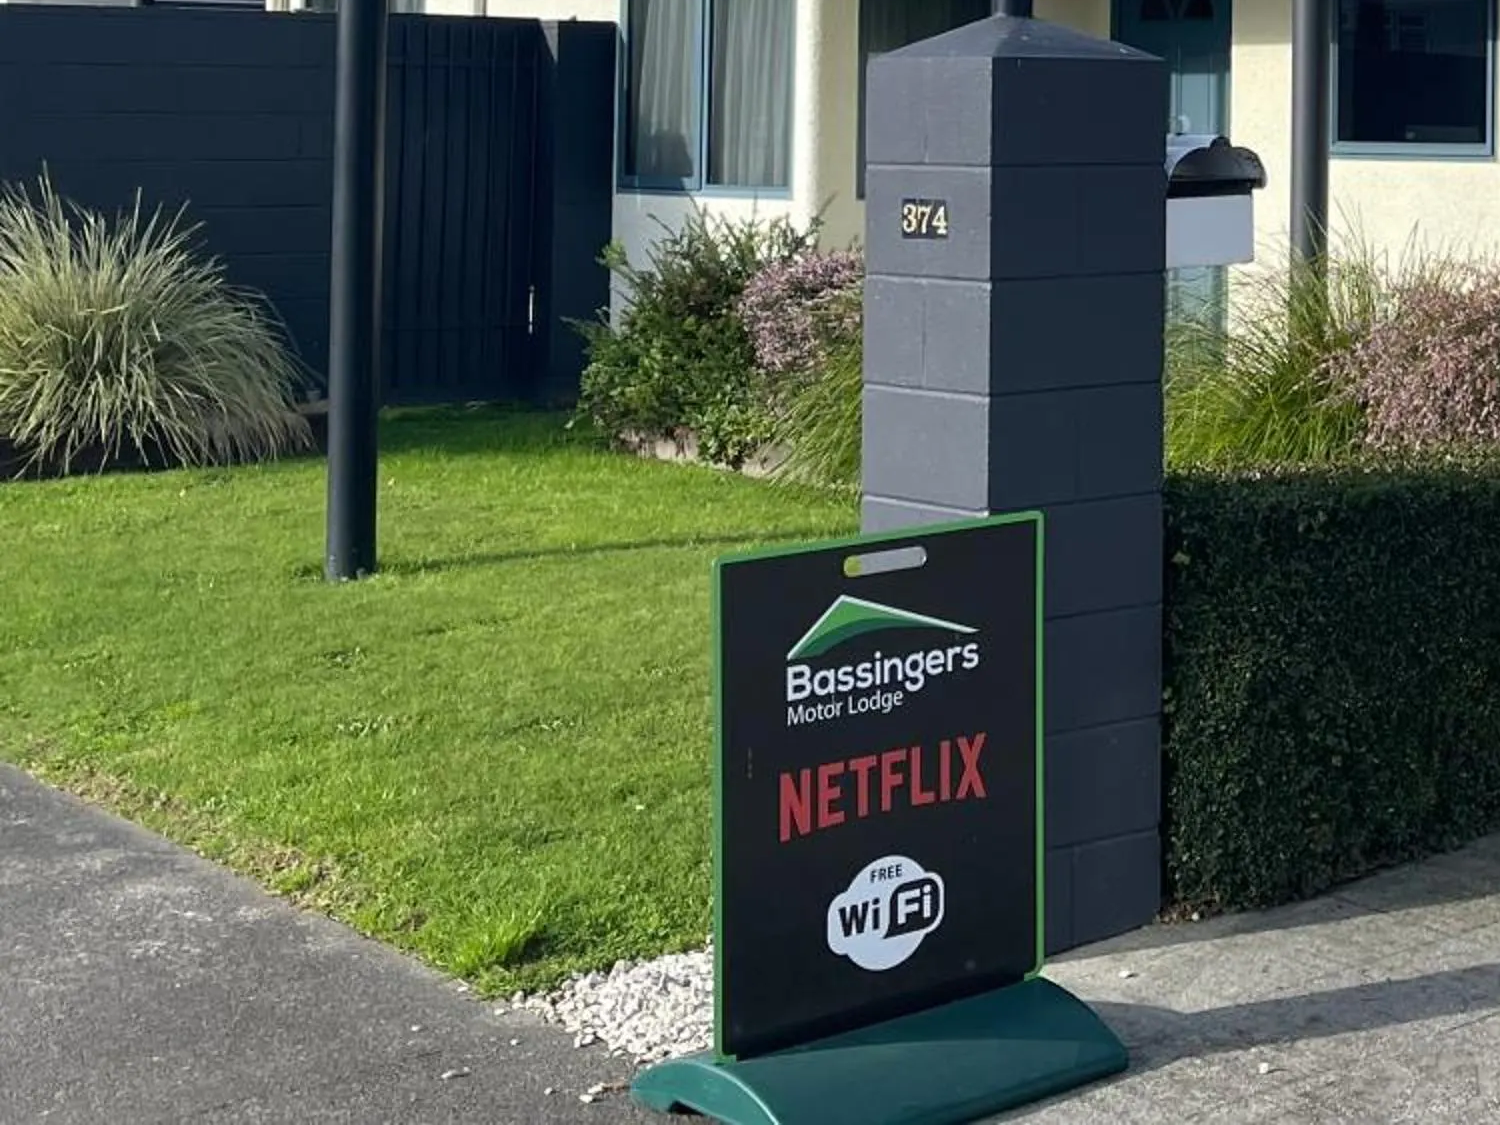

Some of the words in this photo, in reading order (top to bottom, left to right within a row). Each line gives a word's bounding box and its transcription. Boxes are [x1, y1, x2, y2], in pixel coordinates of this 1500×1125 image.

[901, 203, 948, 235] 374
[786, 642, 980, 702] Bassingers
[786, 701, 843, 726] Motor
[848, 690, 904, 714] Lodge
[779, 732, 988, 843] NETFLIX
[869, 863, 904, 883] FREE
